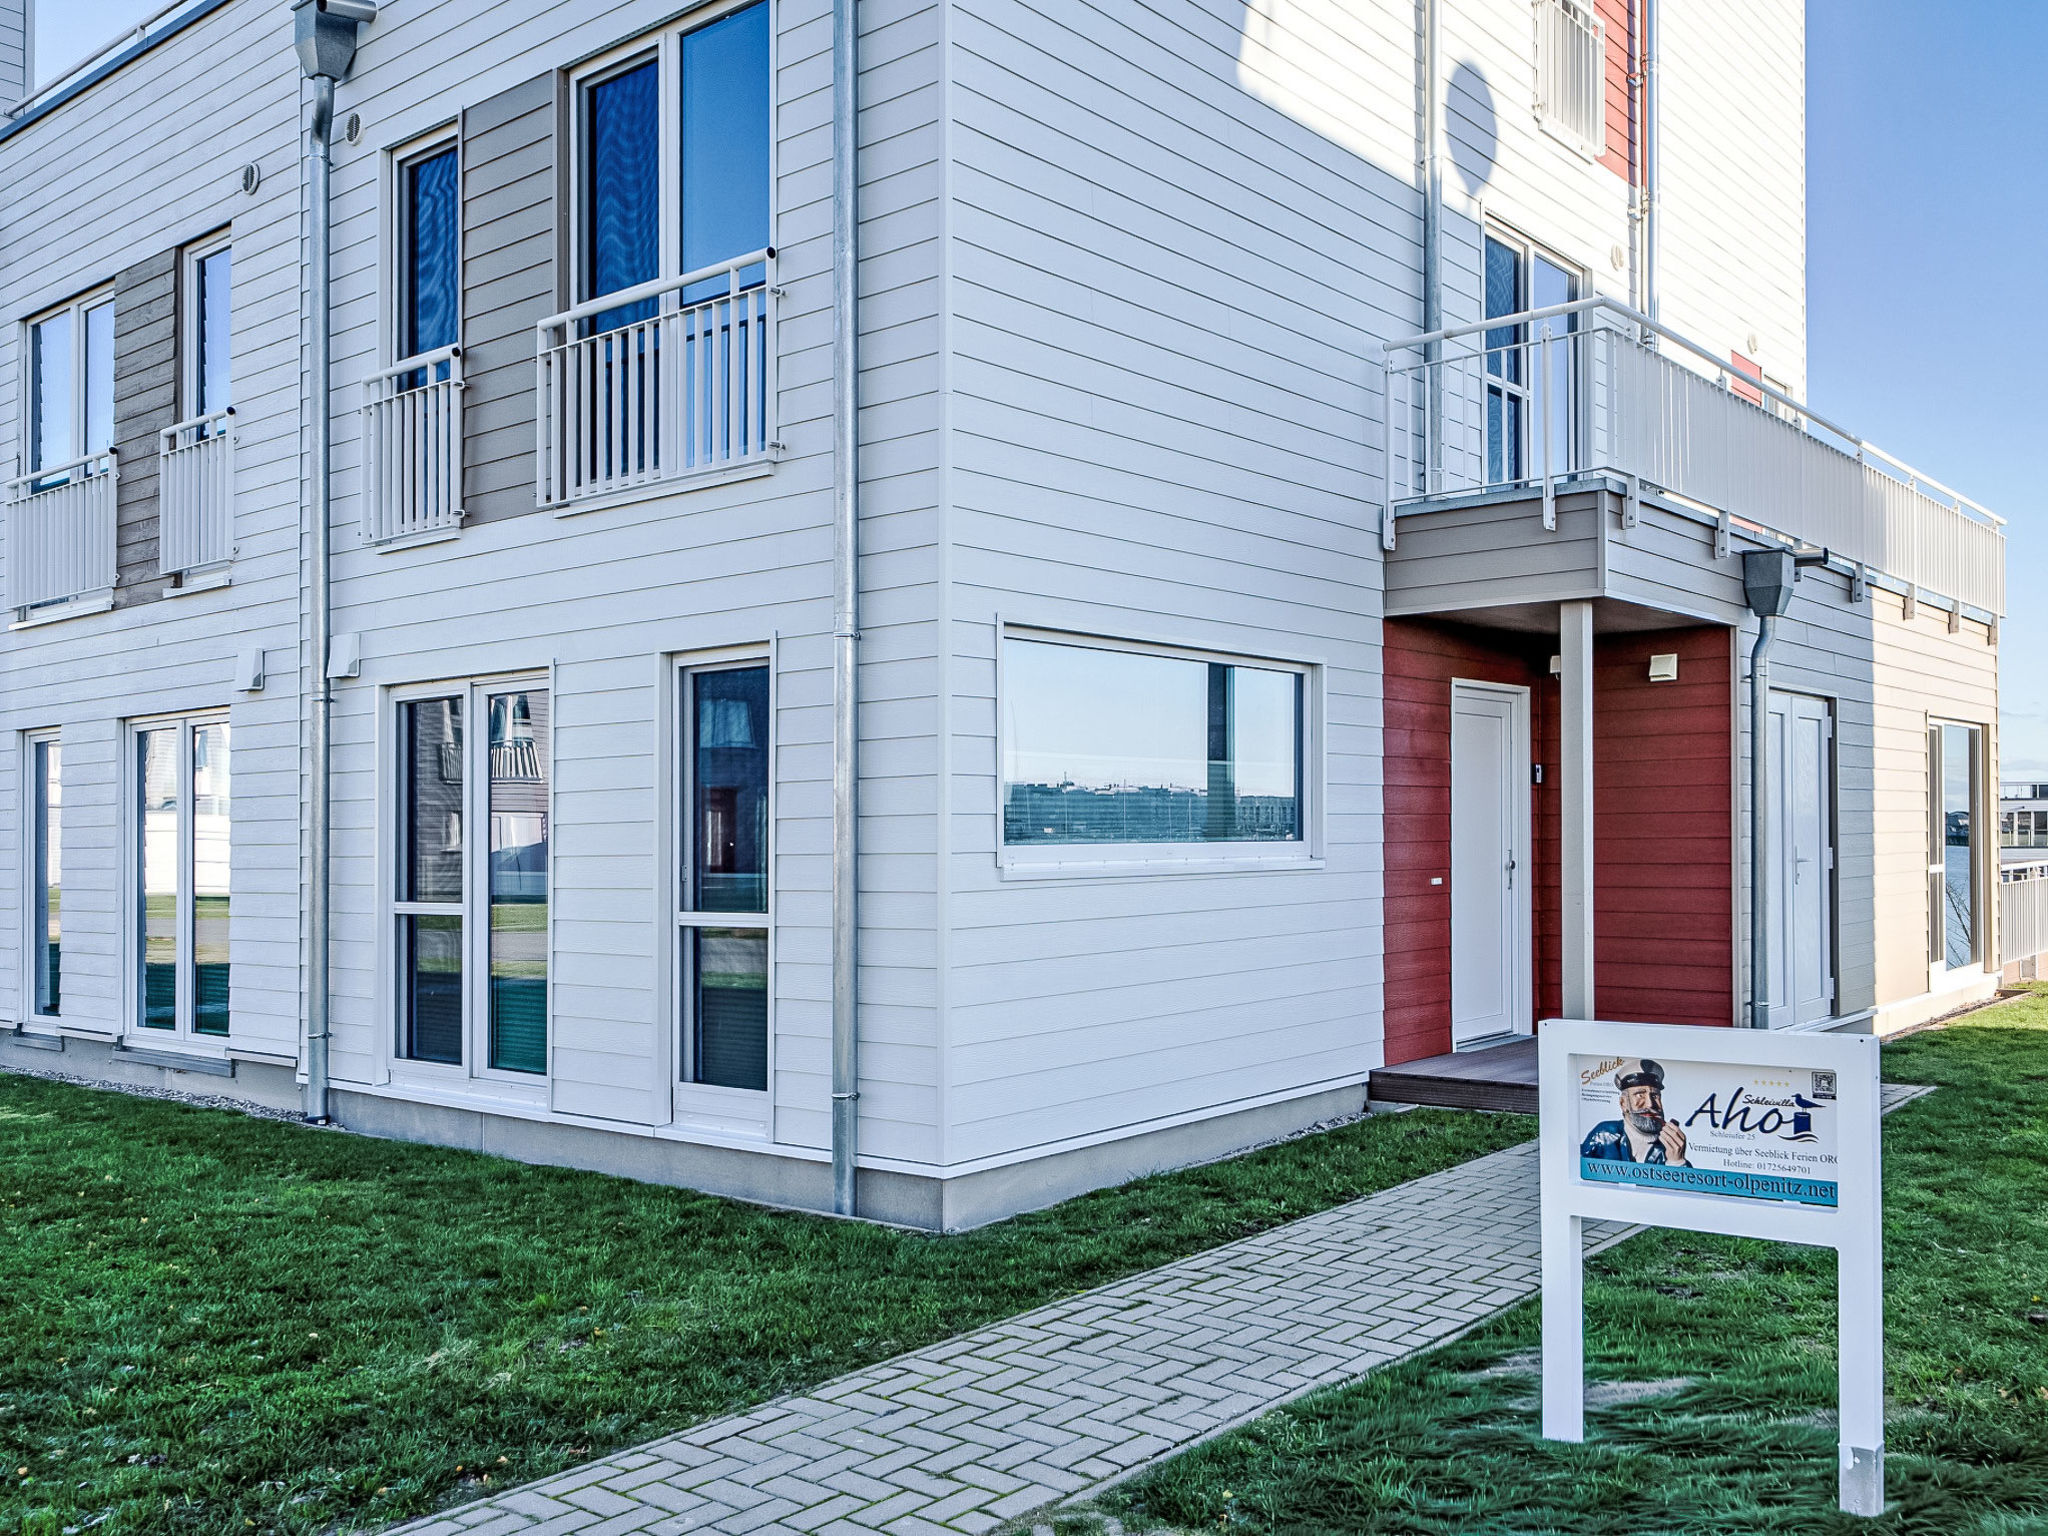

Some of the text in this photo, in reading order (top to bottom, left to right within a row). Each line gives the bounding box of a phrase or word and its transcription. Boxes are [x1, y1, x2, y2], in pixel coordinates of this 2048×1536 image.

[1581, 1056, 1624, 1085] Seeblick
[1688, 1142, 1733, 1157] Vermietung
[1734, 1146, 1752, 1156] über
[1755, 1149, 1789, 1160] Seeblick
[1792, 1151, 1818, 1163] Ferien
[1723, 1159, 1754, 1169] Hotline:
[1588, 1163, 1836, 1198] www.ostseeresort-olpenitz.net
